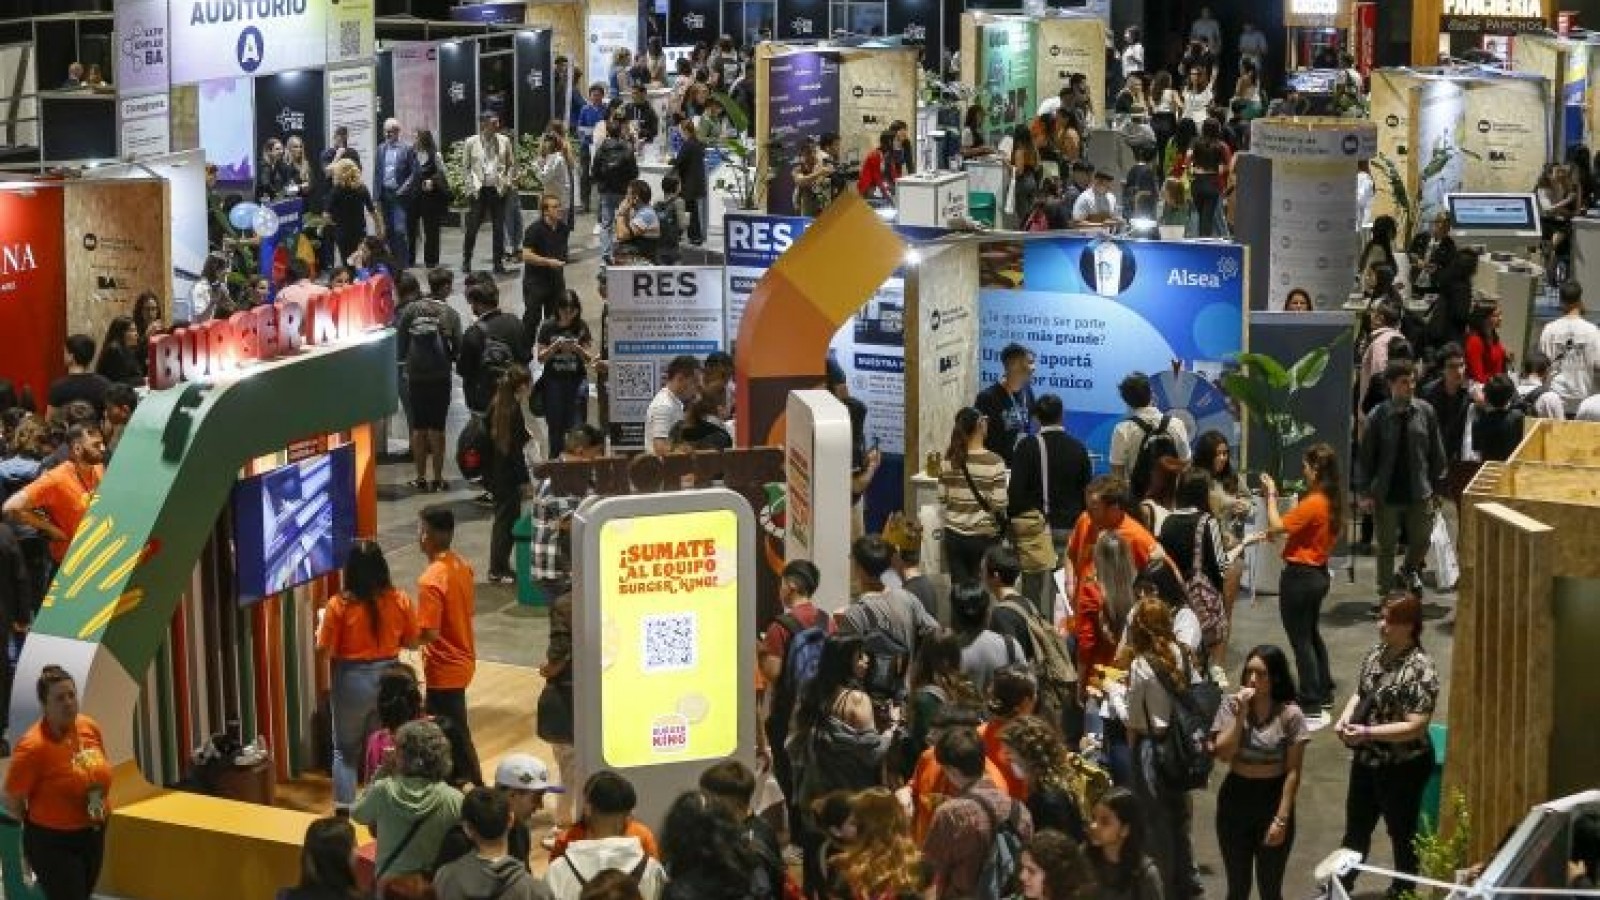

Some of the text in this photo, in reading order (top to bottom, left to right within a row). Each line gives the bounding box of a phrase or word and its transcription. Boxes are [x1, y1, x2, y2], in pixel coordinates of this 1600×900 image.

[191, 0, 307, 25] AUDITORIO
[728, 220, 793, 252] RES
[633, 272, 698, 297] RES
[1167, 269, 1219, 287] Alsea
[1053, 316, 1071, 327] ser
[1075, 318, 1106, 330] parte
[150, 302, 302, 390] BURGER
[1028, 330, 1052, 342] más
[1056, 333, 1106, 346] grande?
[1040, 354, 1092, 369] aportá
[982, 370, 999, 383] tu
[1049, 373, 1093, 388] único
[619, 539, 715, 568] ¡SUMATE
[653, 559, 716, 580] EQUIPO
[619, 580, 678, 594] BURGER
[653, 735, 686, 746] KING
